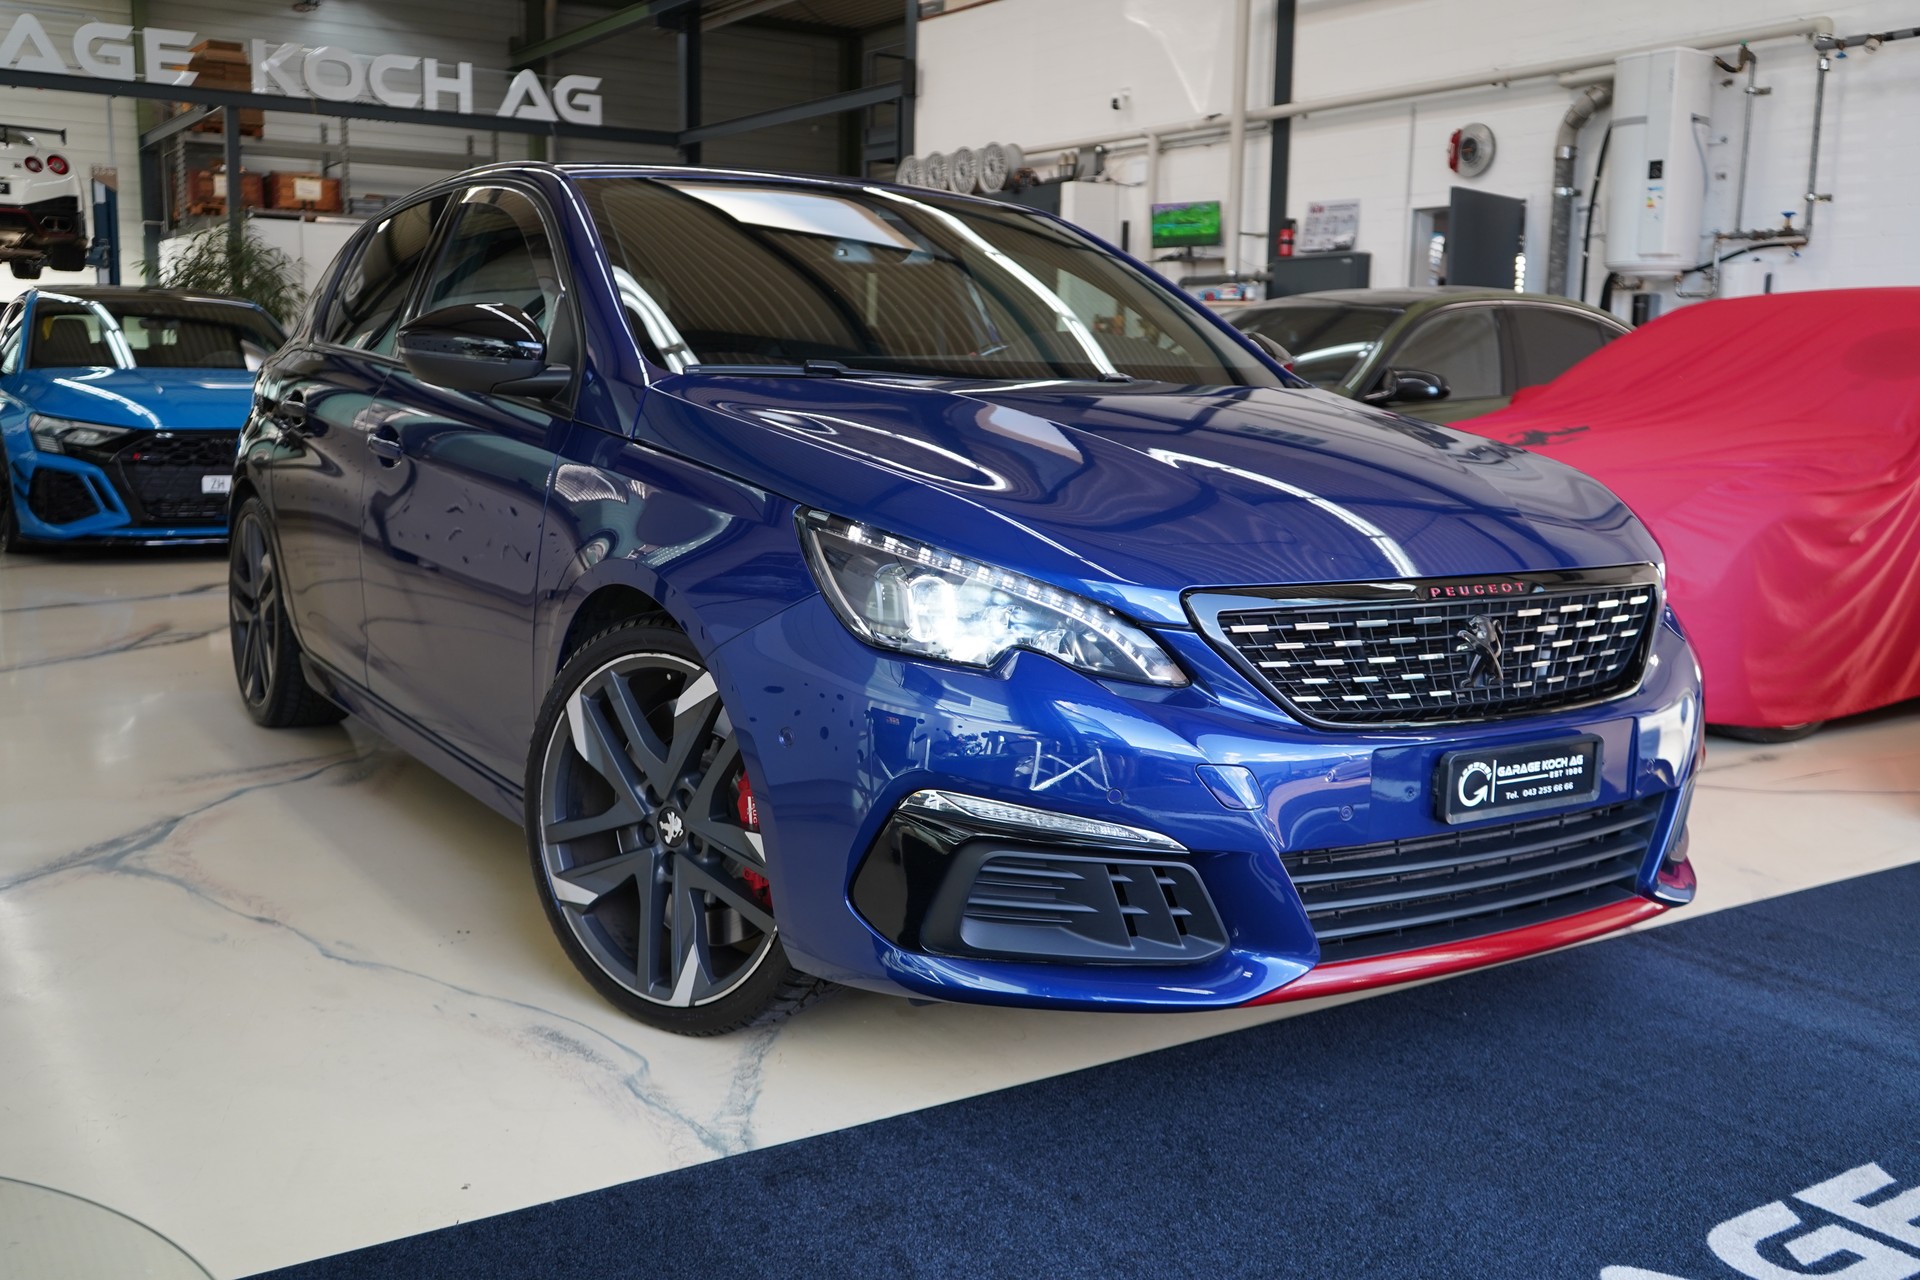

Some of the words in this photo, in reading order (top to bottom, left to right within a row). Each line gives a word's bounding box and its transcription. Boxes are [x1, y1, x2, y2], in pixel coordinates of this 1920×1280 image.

[0, 13, 198, 86] AGE
[250, 39, 473, 115] KOCH
[498, 68, 602, 125] AG
[1430, 582, 1524, 597] PEUGEOT
[1497, 761, 1541, 777] GARAGE
[1542, 757, 1568, 771] KOCH
[1569, 754, 1584, 767] AG
[1549, 769, 1564, 778] EST
[1505, 790, 1519, 800] Tel.
[1522, 788, 1537, 797] 043
[1538, 785, 1552, 795] 255
[1553, 783, 1563, 792] 66
[1564, 781, 1574, 790] 66
[1600, 1162, 1920, 1280] GE
